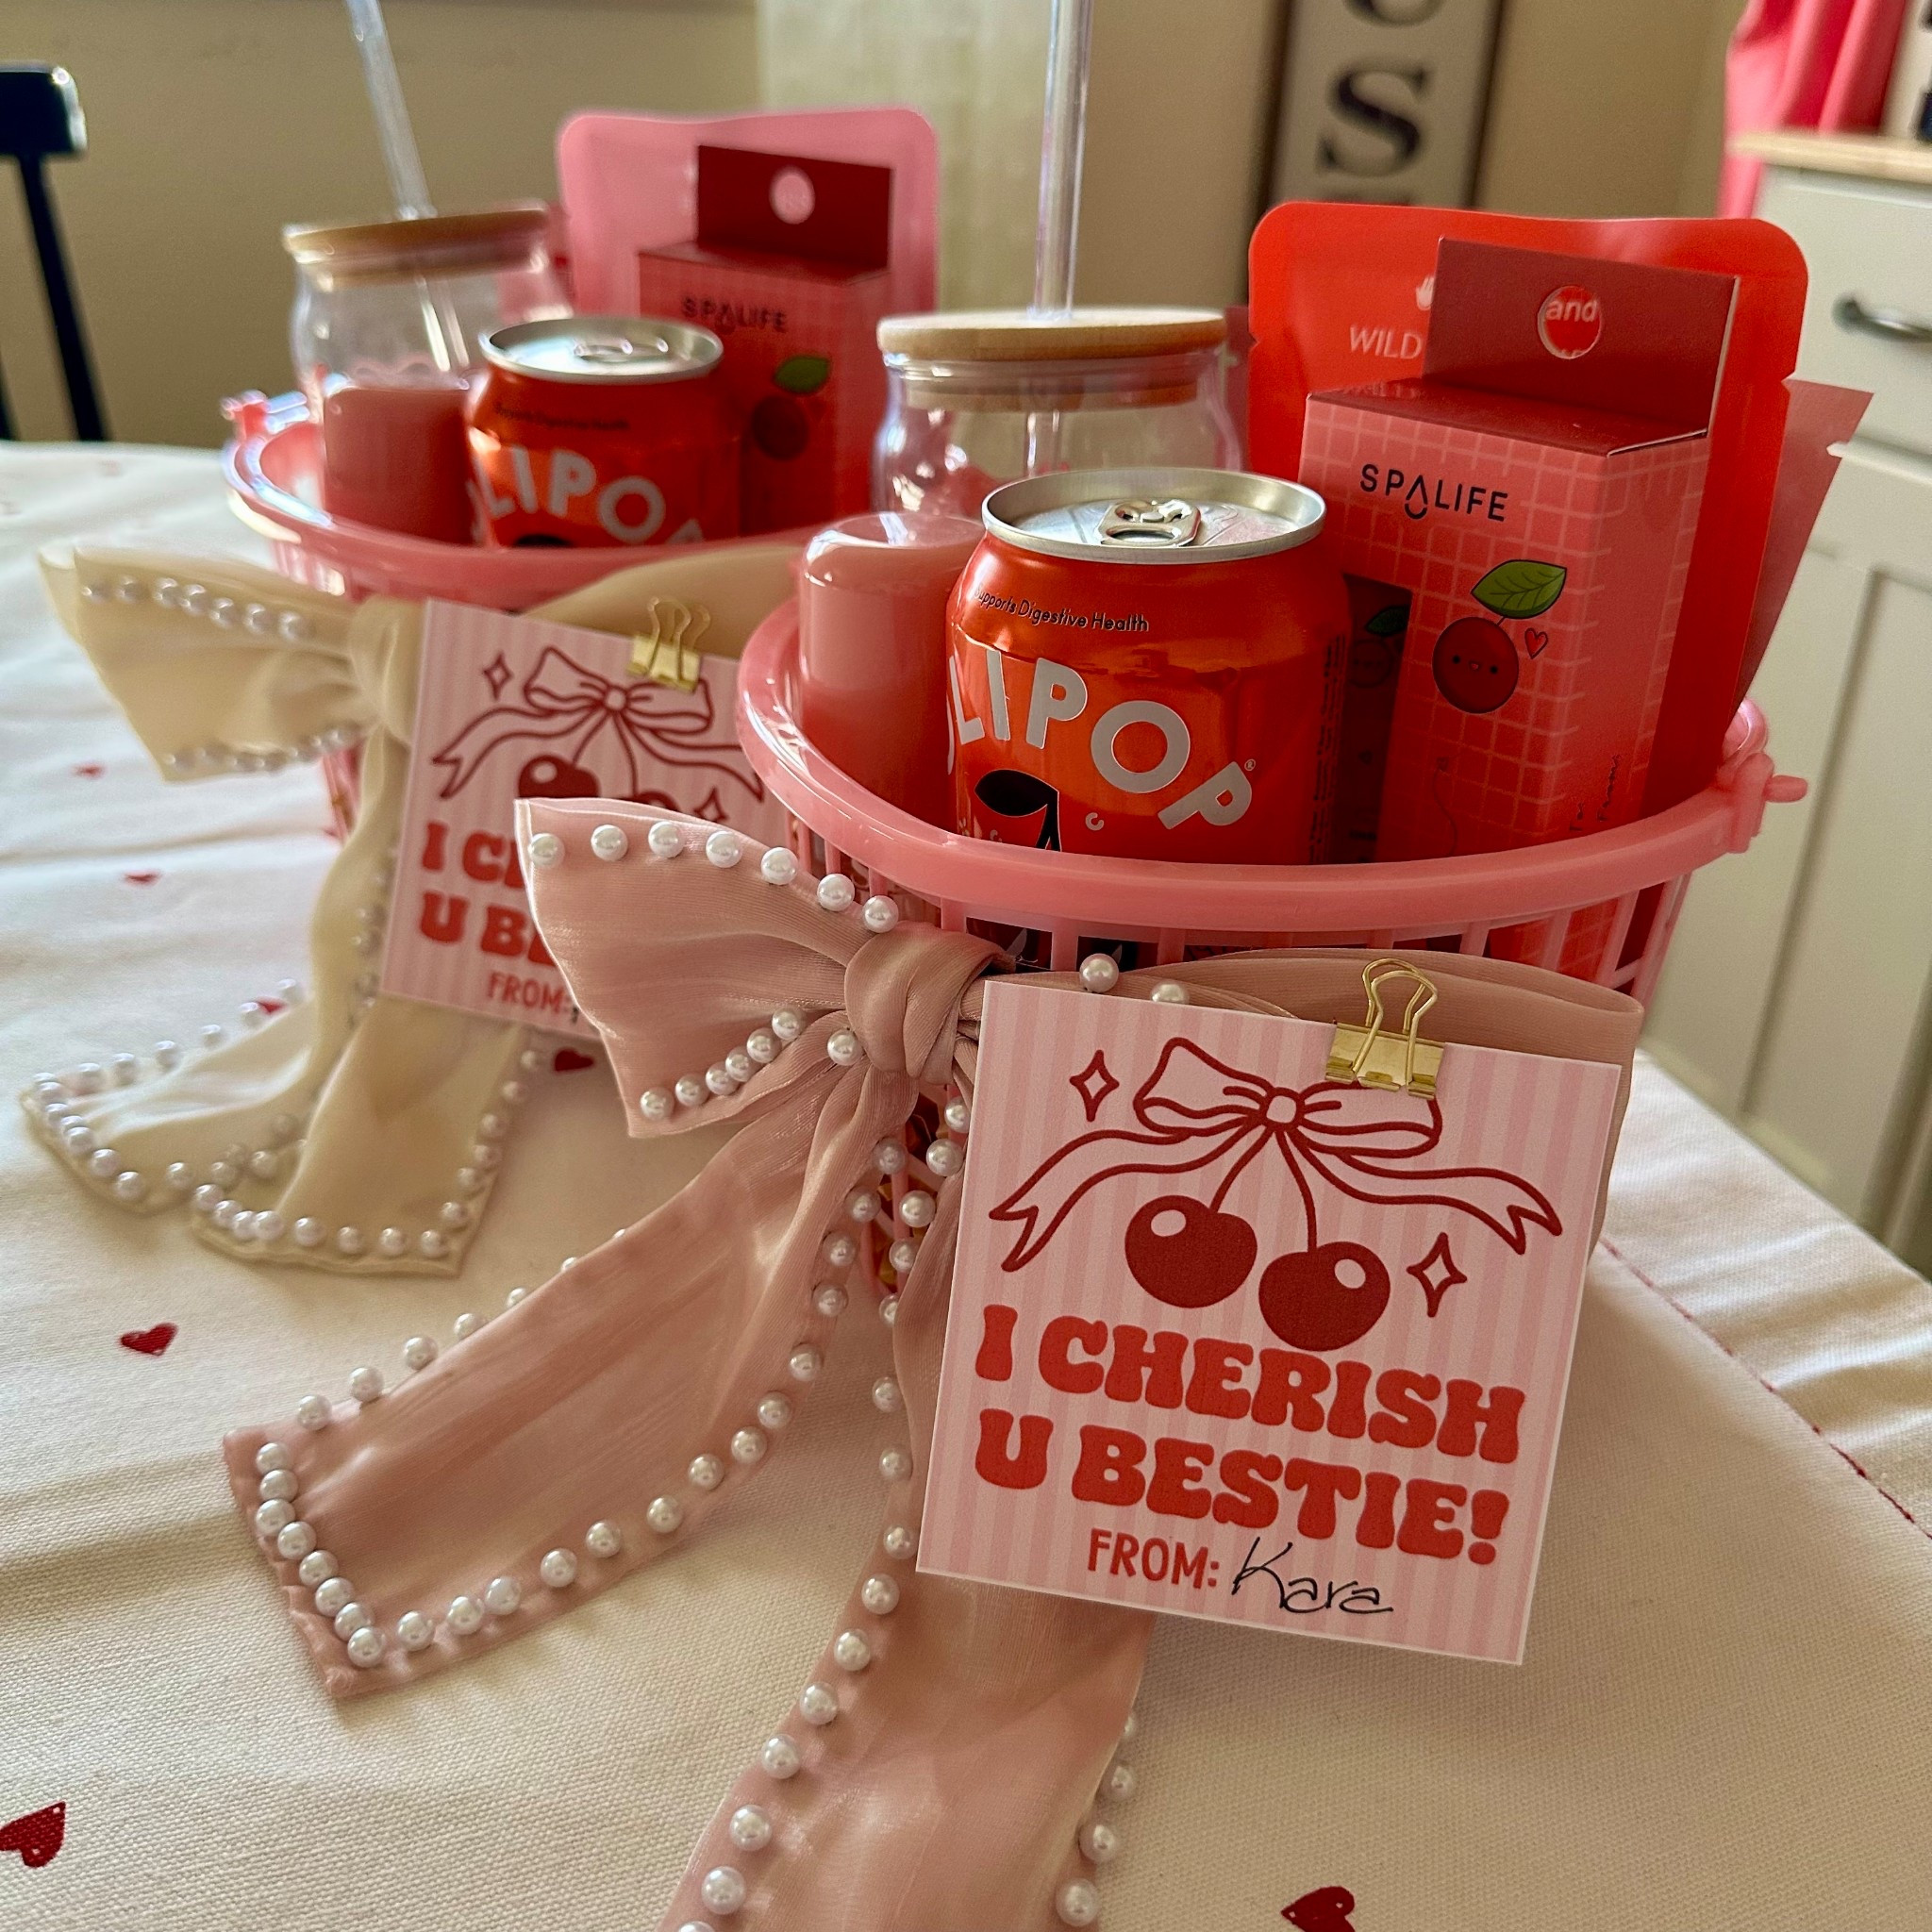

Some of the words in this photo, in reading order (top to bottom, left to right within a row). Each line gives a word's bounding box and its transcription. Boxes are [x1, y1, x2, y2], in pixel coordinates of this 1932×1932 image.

[681, 295, 789, 334] SPALIFE
[1349, 325, 1424, 360] WILD
[1360, 463, 1508, 523] SPALIFE
[1018, 598, 1088, 627] Digestive
[1091, 611, 1149, 632] Health
[422, 821, 448, 872] I
[419, 891, 469, 943] U
[974, 1304, 1018, 1382] I
[1039, 1315, 1525, 1464] CHERISH
[974, 1407, 1054, 1490] U
[1072, 1424, 1510, 1566] BESTIE!
[1087, 1527, 1220, 1590] FROM:
[1230, 1536, 1394, 1614] Kara
